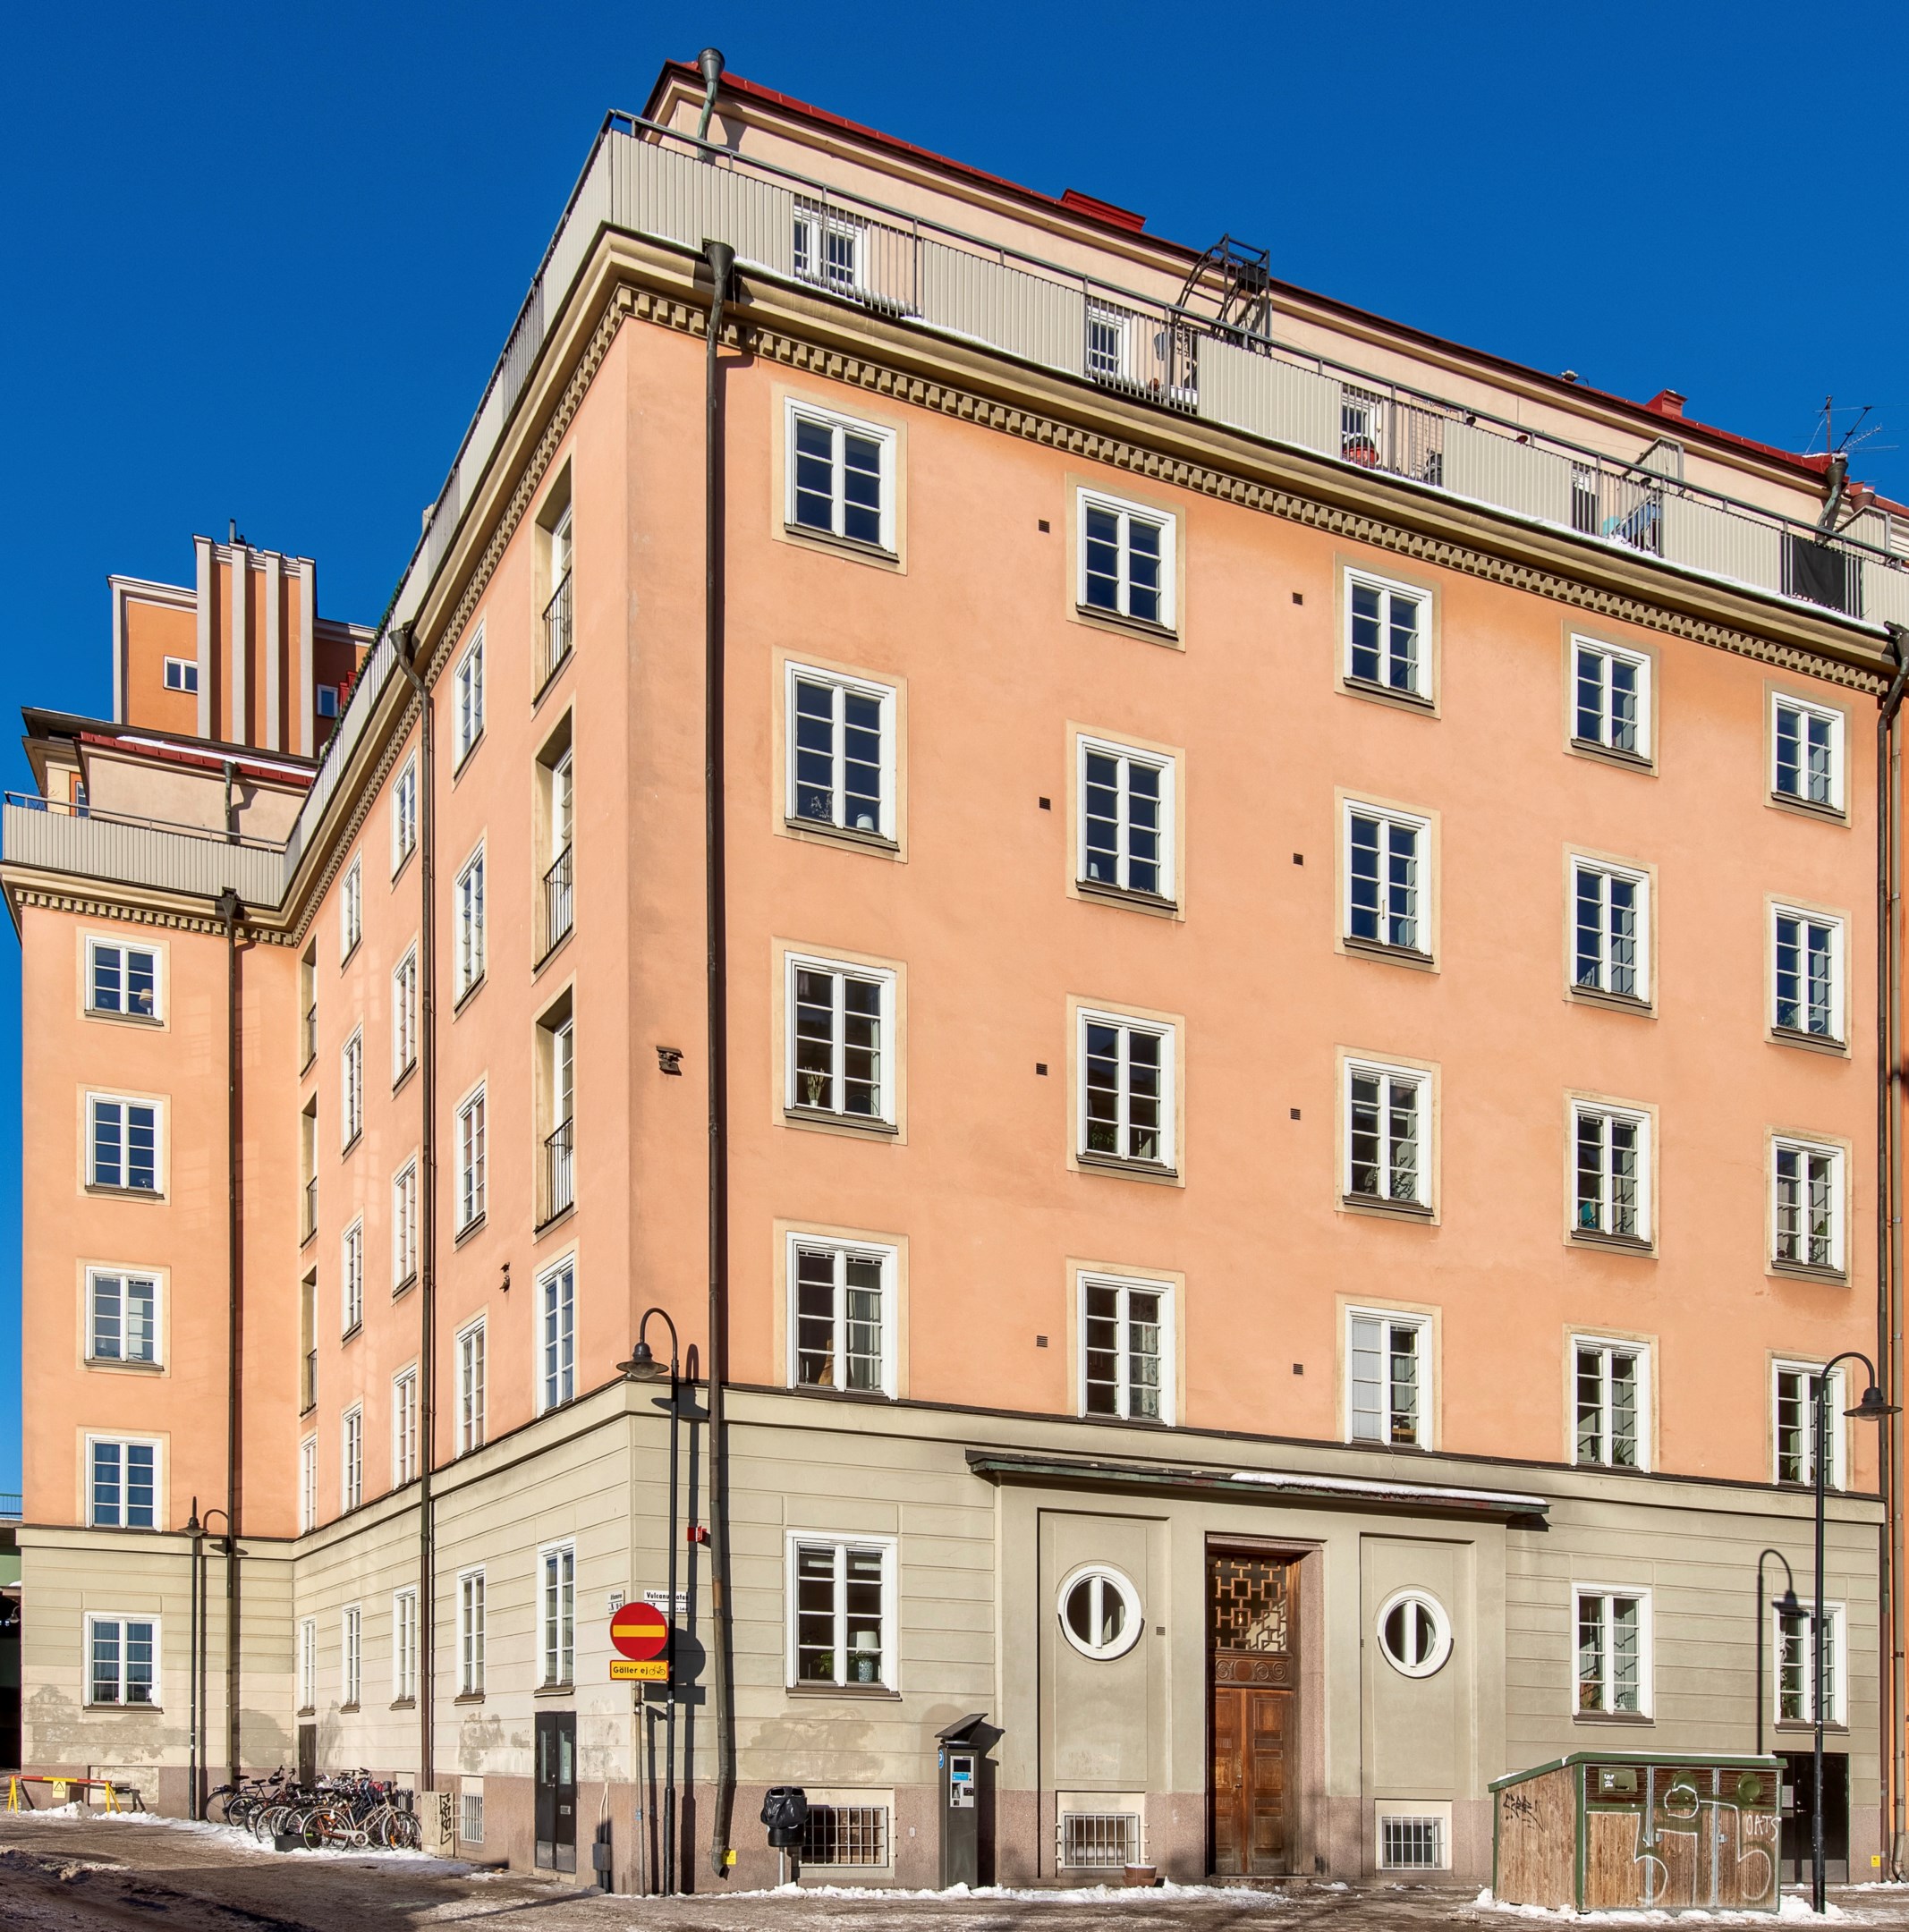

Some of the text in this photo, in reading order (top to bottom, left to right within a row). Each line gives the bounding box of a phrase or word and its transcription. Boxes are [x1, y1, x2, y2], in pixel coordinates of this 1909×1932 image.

[646, 1591, 689, 1600] Vulcanuatan
[613, 1665, 649, 1675] Gäller ej
